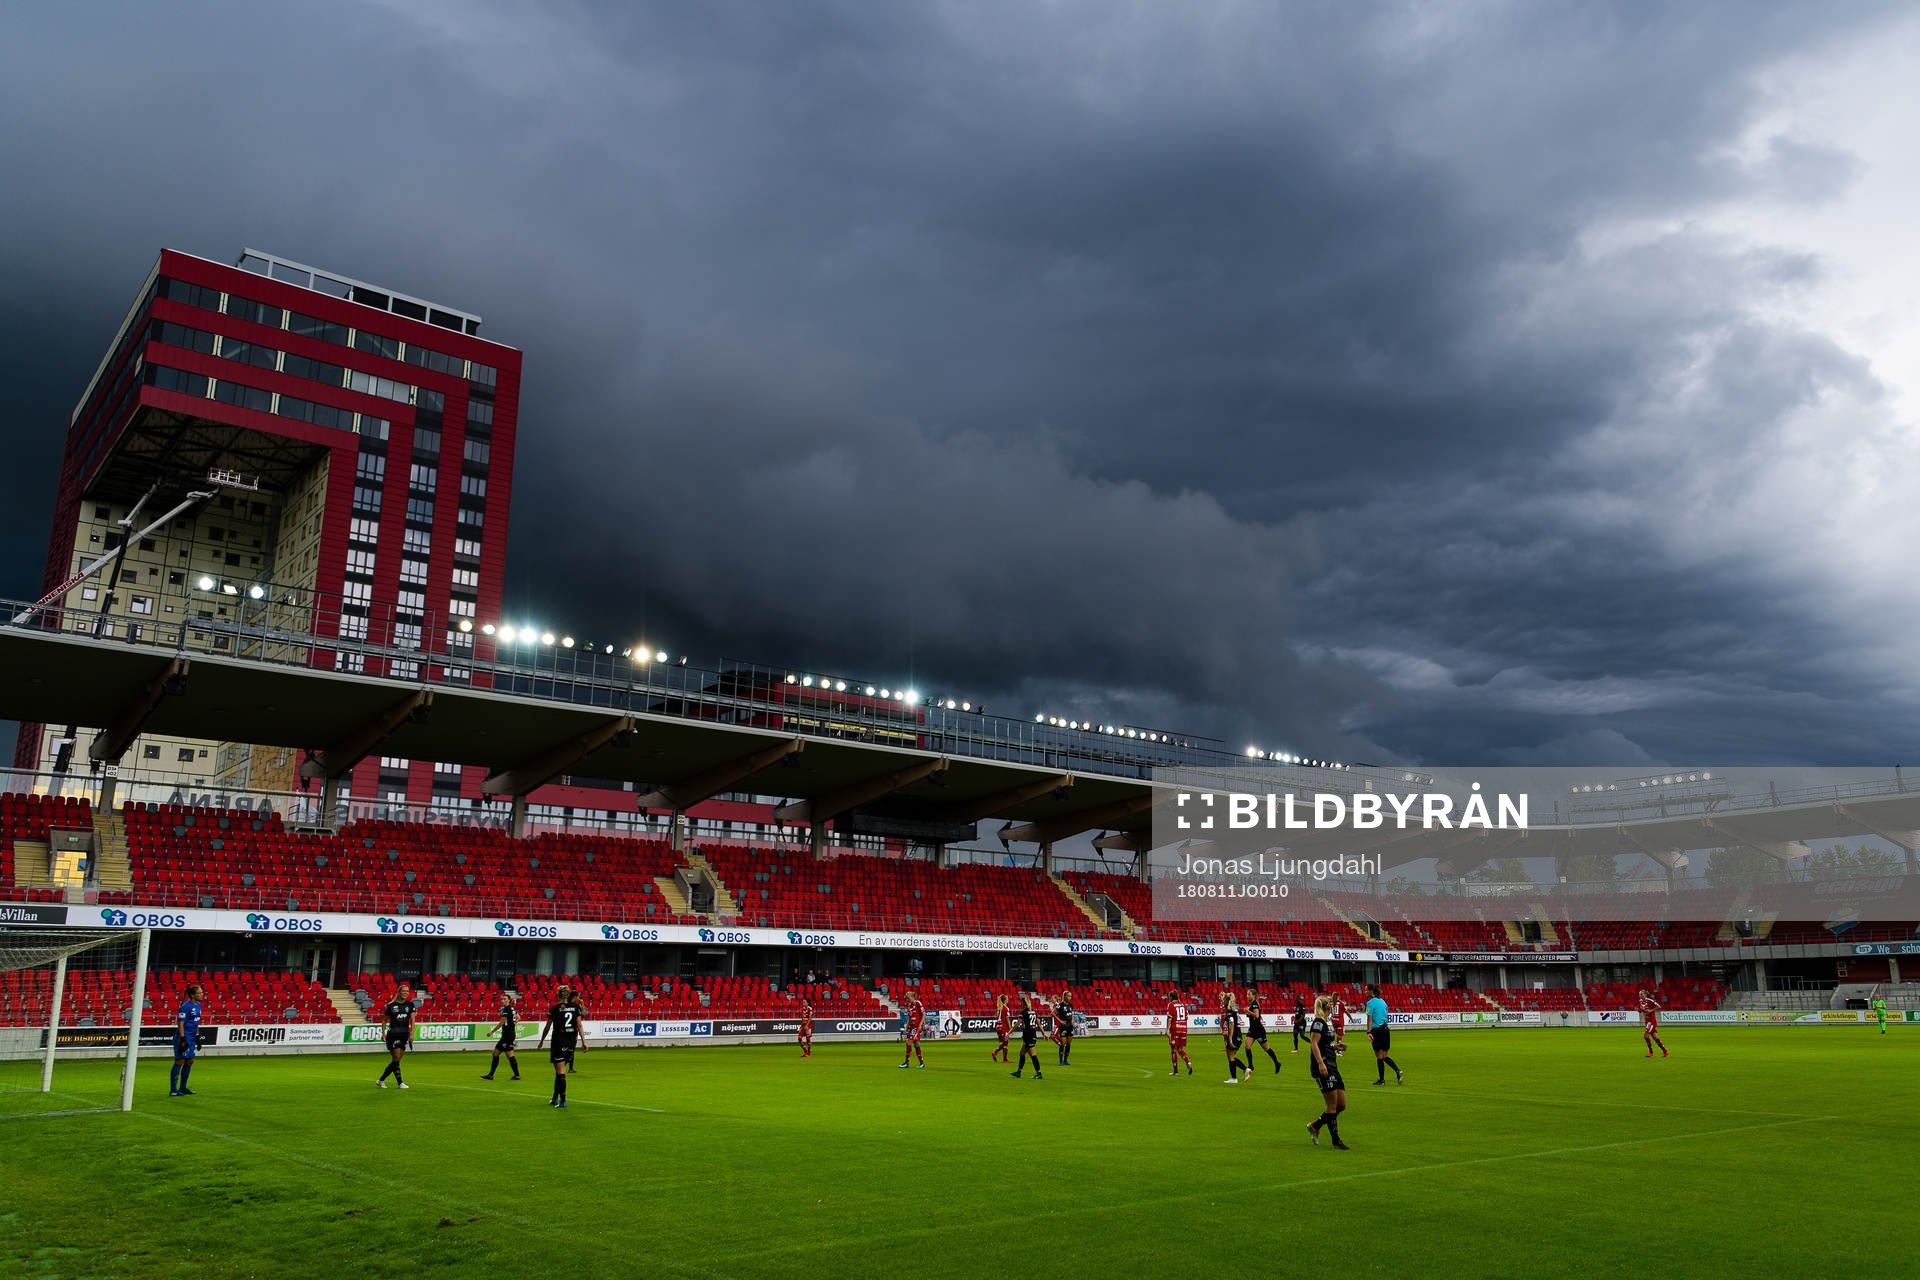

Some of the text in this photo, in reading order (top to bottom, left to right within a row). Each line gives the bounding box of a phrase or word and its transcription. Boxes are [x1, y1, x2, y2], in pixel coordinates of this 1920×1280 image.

[132, 913, 186, 928] OBOS
[274, 918, 323, 932] OBOS
[402, 921, 445, 935] OBOS
[518, 925, 557, 938] OBOS
[622, 928, 658, 941] OBOS
[717, 932, 751, 943] OBOS
[804, 934, 835, 945] OBOS
[858, 934, 1049, 951] En av nordens största bostadsutvecklare
[1081, 943, 1104, 953] OBOS
[1140, 945, 1162, 955] OBOS
[1195, 947, 1216, 956] OBOS
[1247, 949, 1267, 958] OBOS
[1296, 950, 1314, 959] OBOS
[1877, 944, 1890, 954] We
[1341, 952, 1359, 960] OBOS
[1385, 953, 1401, 961] OBOS
[1175, 1006, 1186, 1021] 19
[1661, 1012, 1736, 1021] NeaEntremattor.se
[564, 1012, 573, 1028] 2
[968, 1020, 998, 1029] CRAFT
[1029, 1014, 1037, 1026] 22
[638, 1023, 653, 1034] ÅC
[694, 1023, 708, 1033] ÅC
[721, 1023, 757, 1033] nöjesnytt
[773, 1023, 801, 1032] nöjesny
[836, 1021, 886, 1031] OTTOSSON
[229, 1027, 286, 1044] ecosign
[351, 1026, 383, 1041] ecos
[420, 1024, 469, 1041] ecosign
